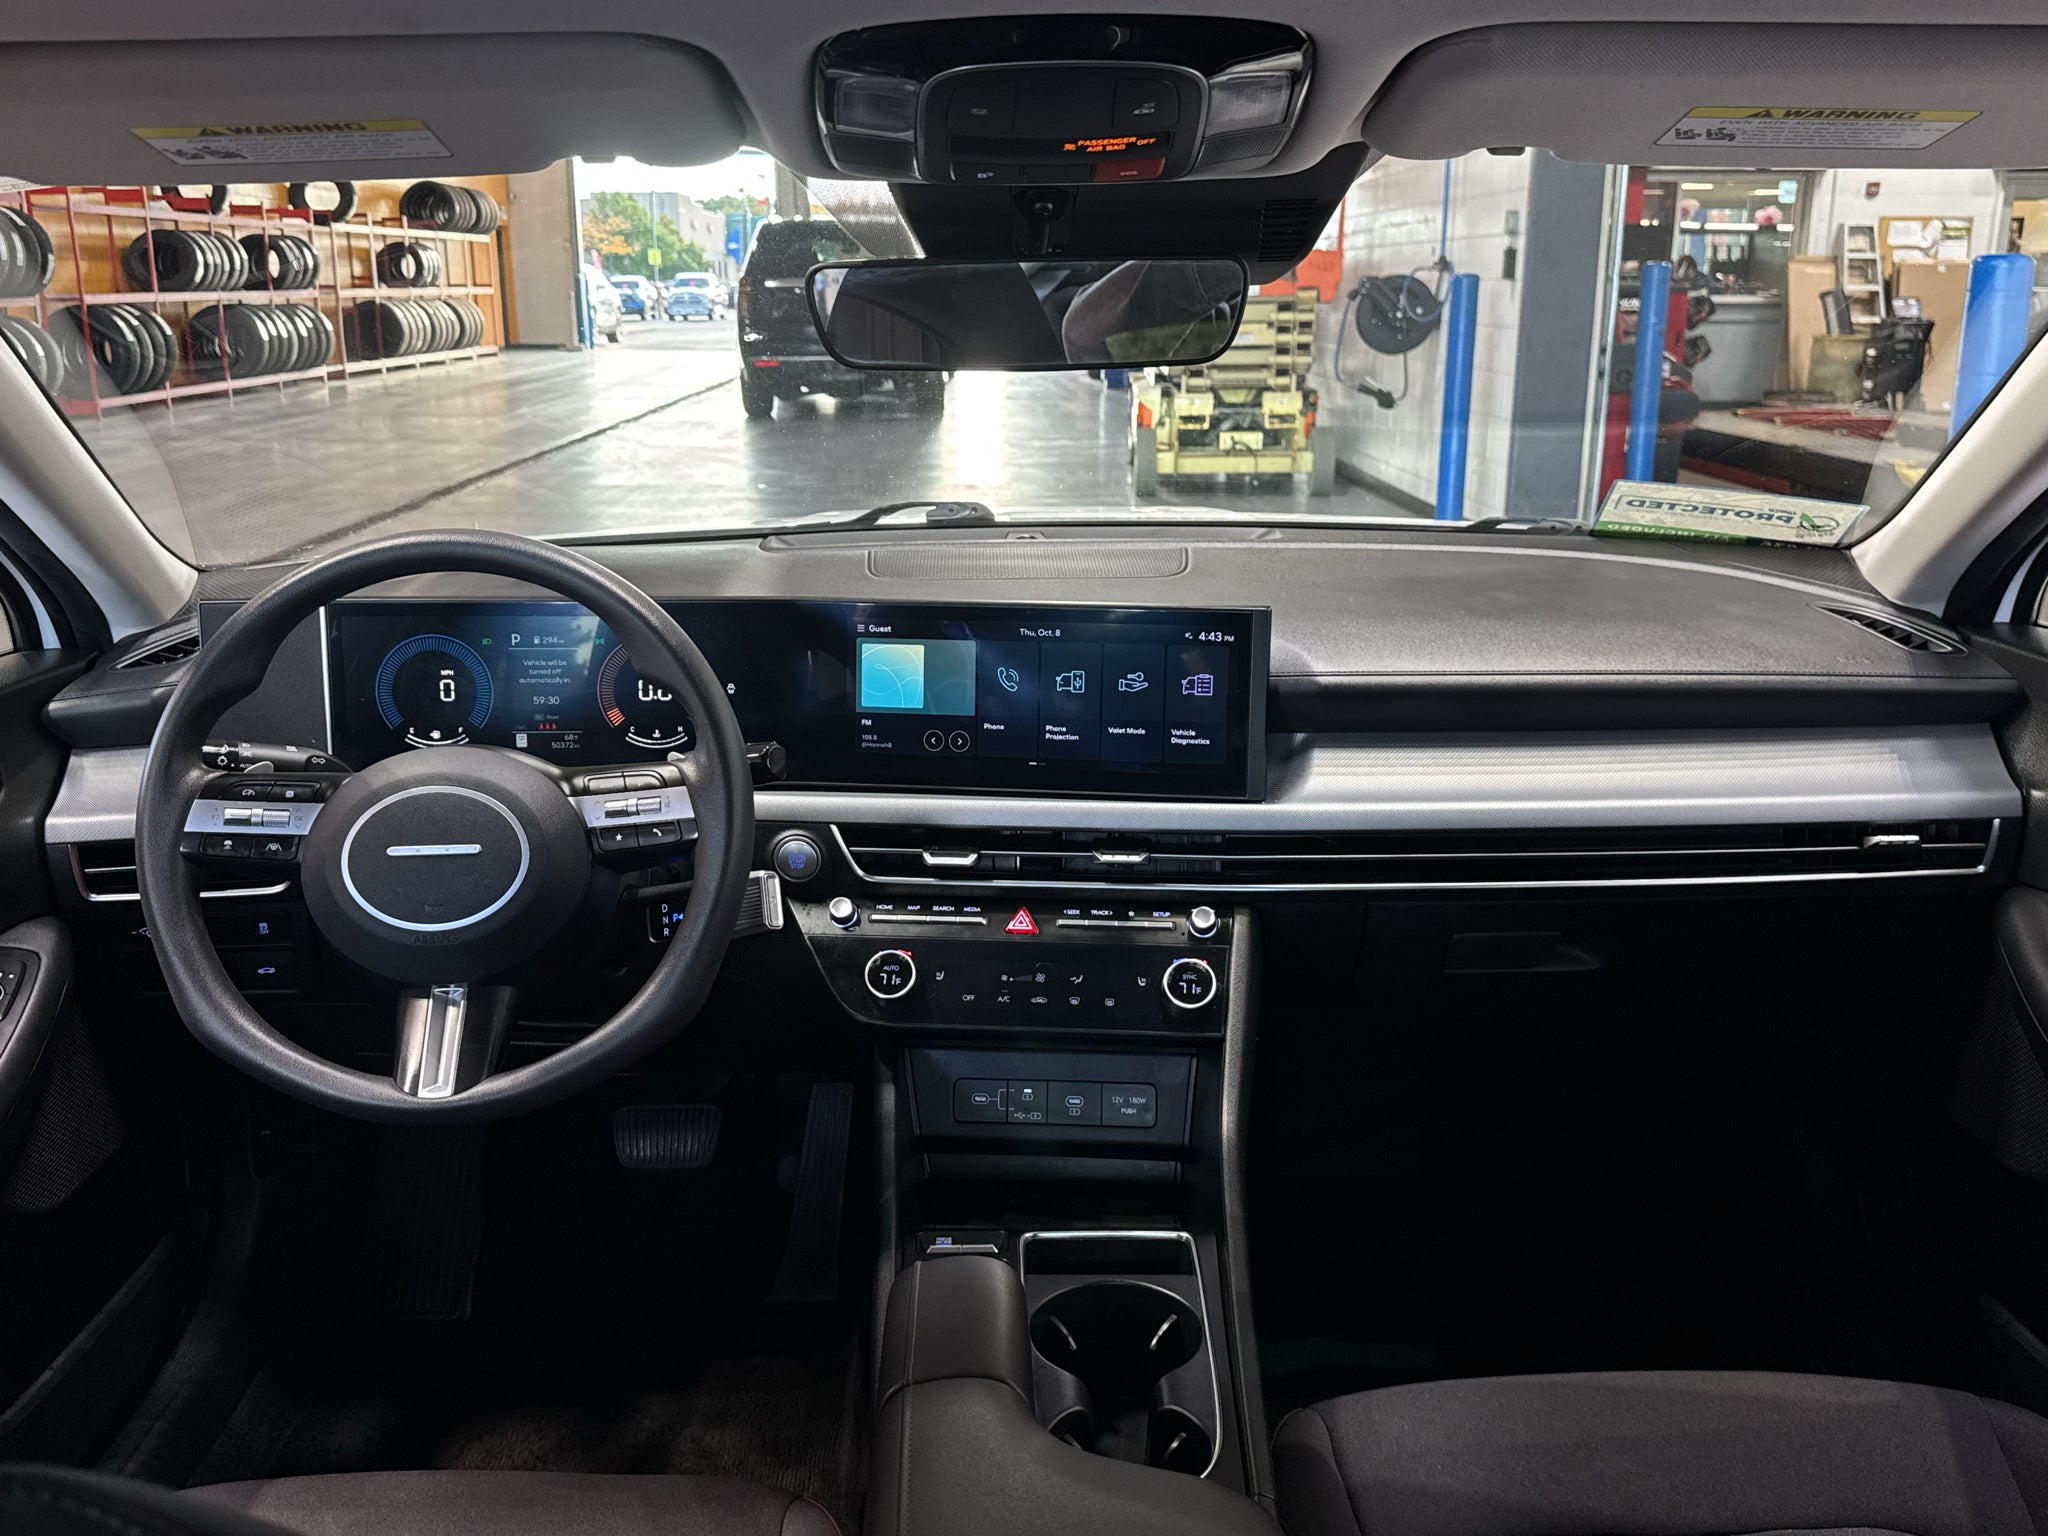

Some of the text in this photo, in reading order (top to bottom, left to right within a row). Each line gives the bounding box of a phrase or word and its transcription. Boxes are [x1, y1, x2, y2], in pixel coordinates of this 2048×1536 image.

[1782, 109, 1920, 120] WARNING
[227, 122, 368, 136] WARNING
[1077, 136, 1157, 147] PASSENGER OFF
[868, 624, 892, 634] Guest
[1019, 628, 1036, 638] Thu,
[1055, 628, 1061, 637] 8
[511, 633, 521, 646] P
[542, 636, 558, 644] 294
[1198, 631, 1222, 642] 4:43
[519, 676, 562, 685] automatically
[439, 679, 456, 702] 0
[533, 695, 560, 705] 59:30
[861, 718, 873, 726] FM
[983, 722, 1005, 730] Phone
[458, 726, 464, 734] F
[1045, 724, 1067, 732] Phone
[1108, 726, 1146, 735] Valet Mode
[1171, 728, 1196, 736] Vehicle
[1045, 733, 1080, 741] Projection
[1171, 736, 1210, 745] Diagnostics
[551, 741, 574, 749] 50372
[661, 903, 668, 913] D
[662, 915, 669, 925] N
[672, 913, 679, 923] P
[663, 927, 670, 937] R
[962, 993, 976, 1002] OFF
[997, 995, 1011, 1003] A/C
[1111, 1095, 1124, 1104] 12V
[1120, 1107, 1137, 1115] PUSH
